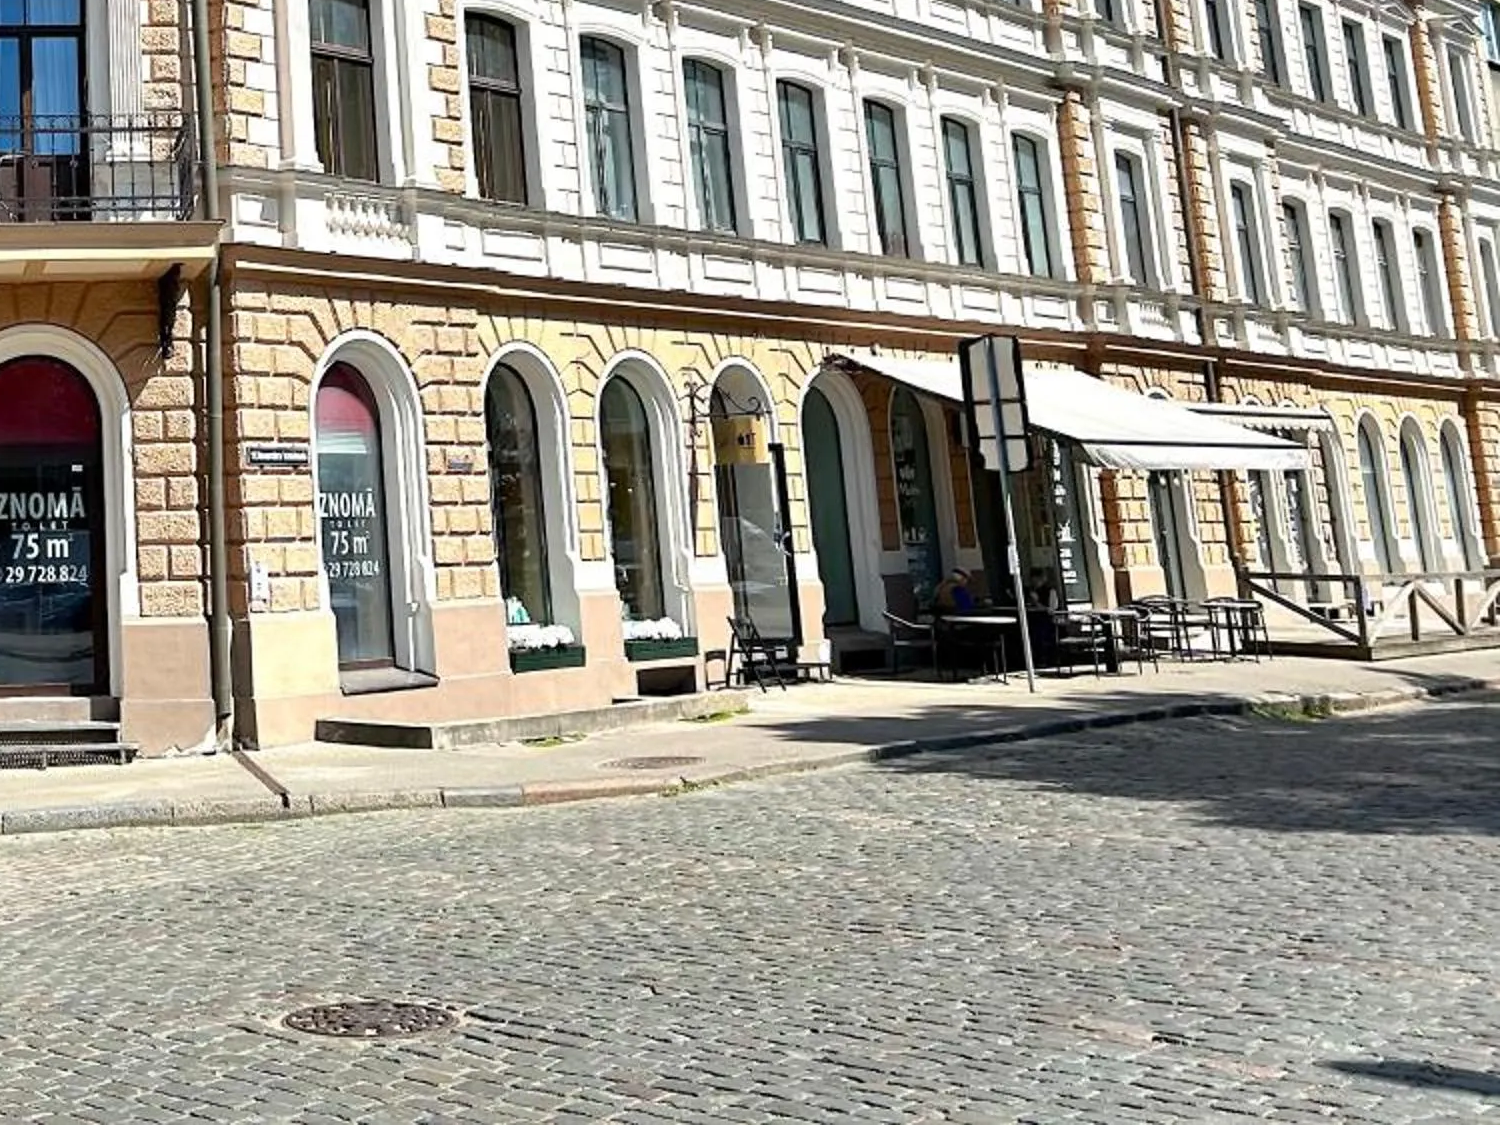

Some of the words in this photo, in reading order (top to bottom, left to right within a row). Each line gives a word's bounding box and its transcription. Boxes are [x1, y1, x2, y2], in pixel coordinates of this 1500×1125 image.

[319, 487, 376, 518] ZNOMĀ
[10, 533, 40, 560] 75
[330, 530, 349, 555] 75
